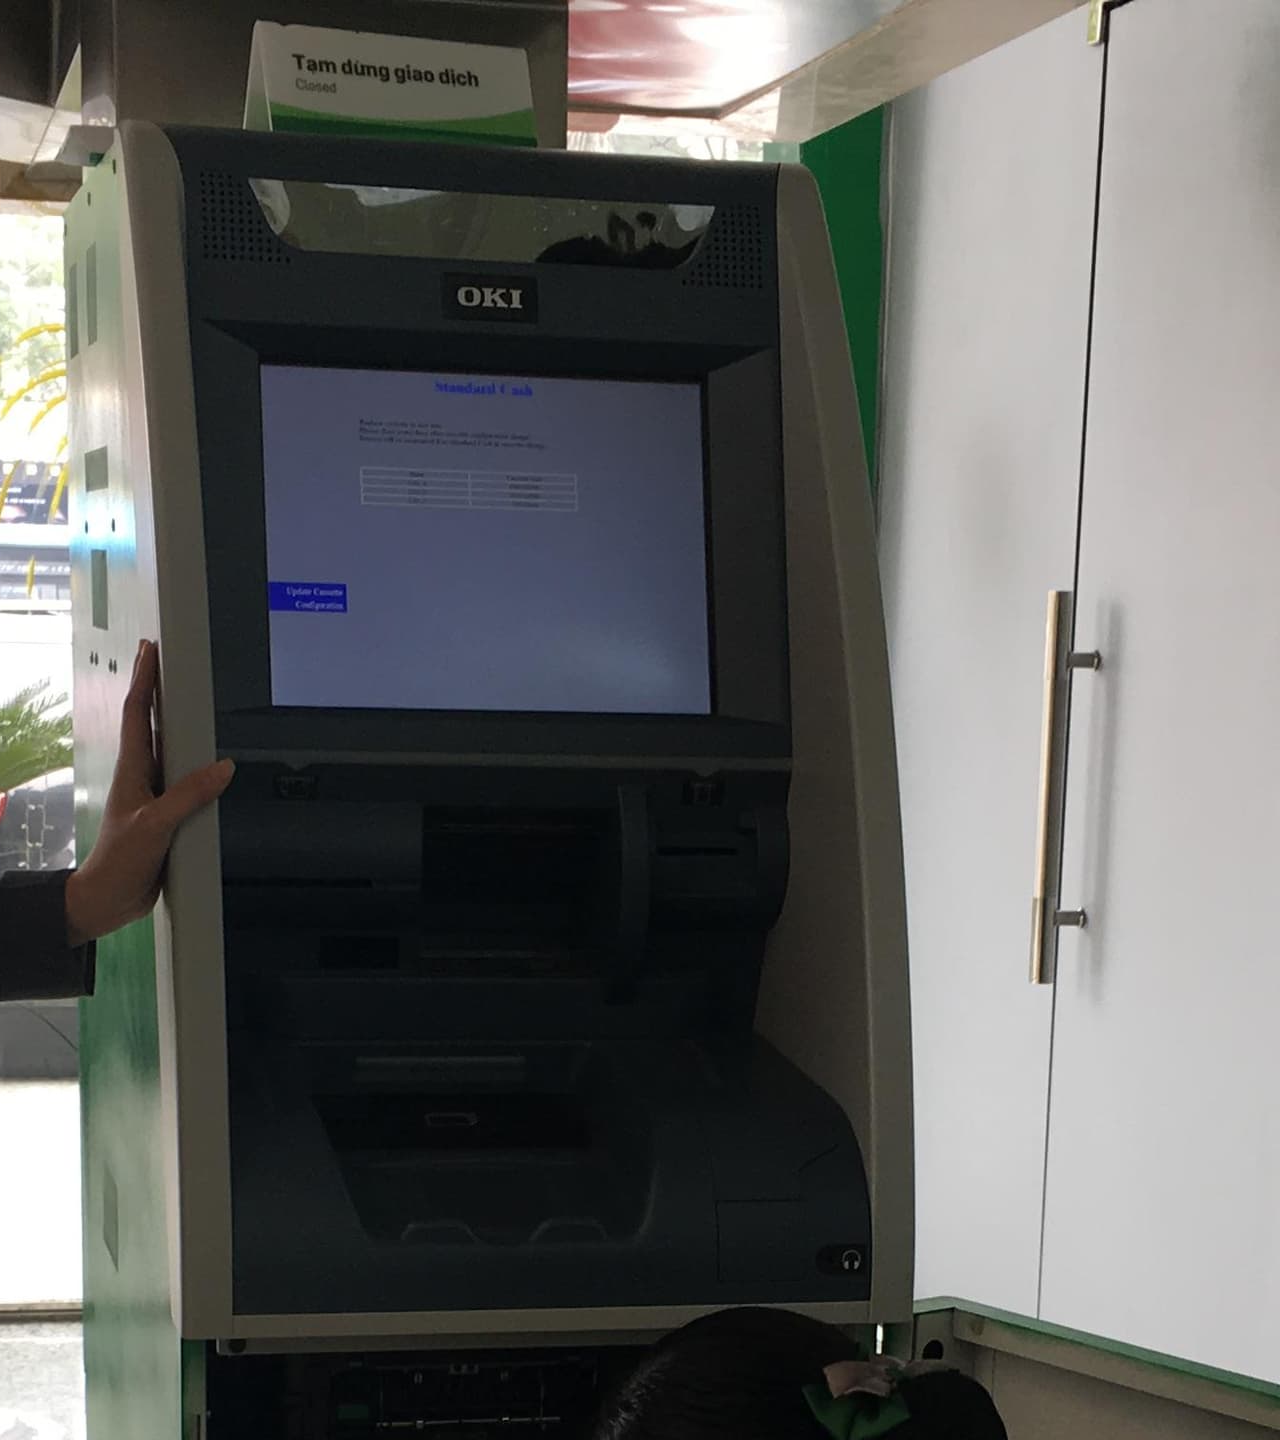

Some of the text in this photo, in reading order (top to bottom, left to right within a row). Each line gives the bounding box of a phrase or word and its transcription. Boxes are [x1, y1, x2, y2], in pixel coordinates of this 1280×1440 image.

[291, 53, 337, 75] Tạm
[394, 64, 435, 84] giao
[439, 67, 480, 88] dịch
[295, 78, 337, 93] Closed
[457, 286, 523, 309] OKI
